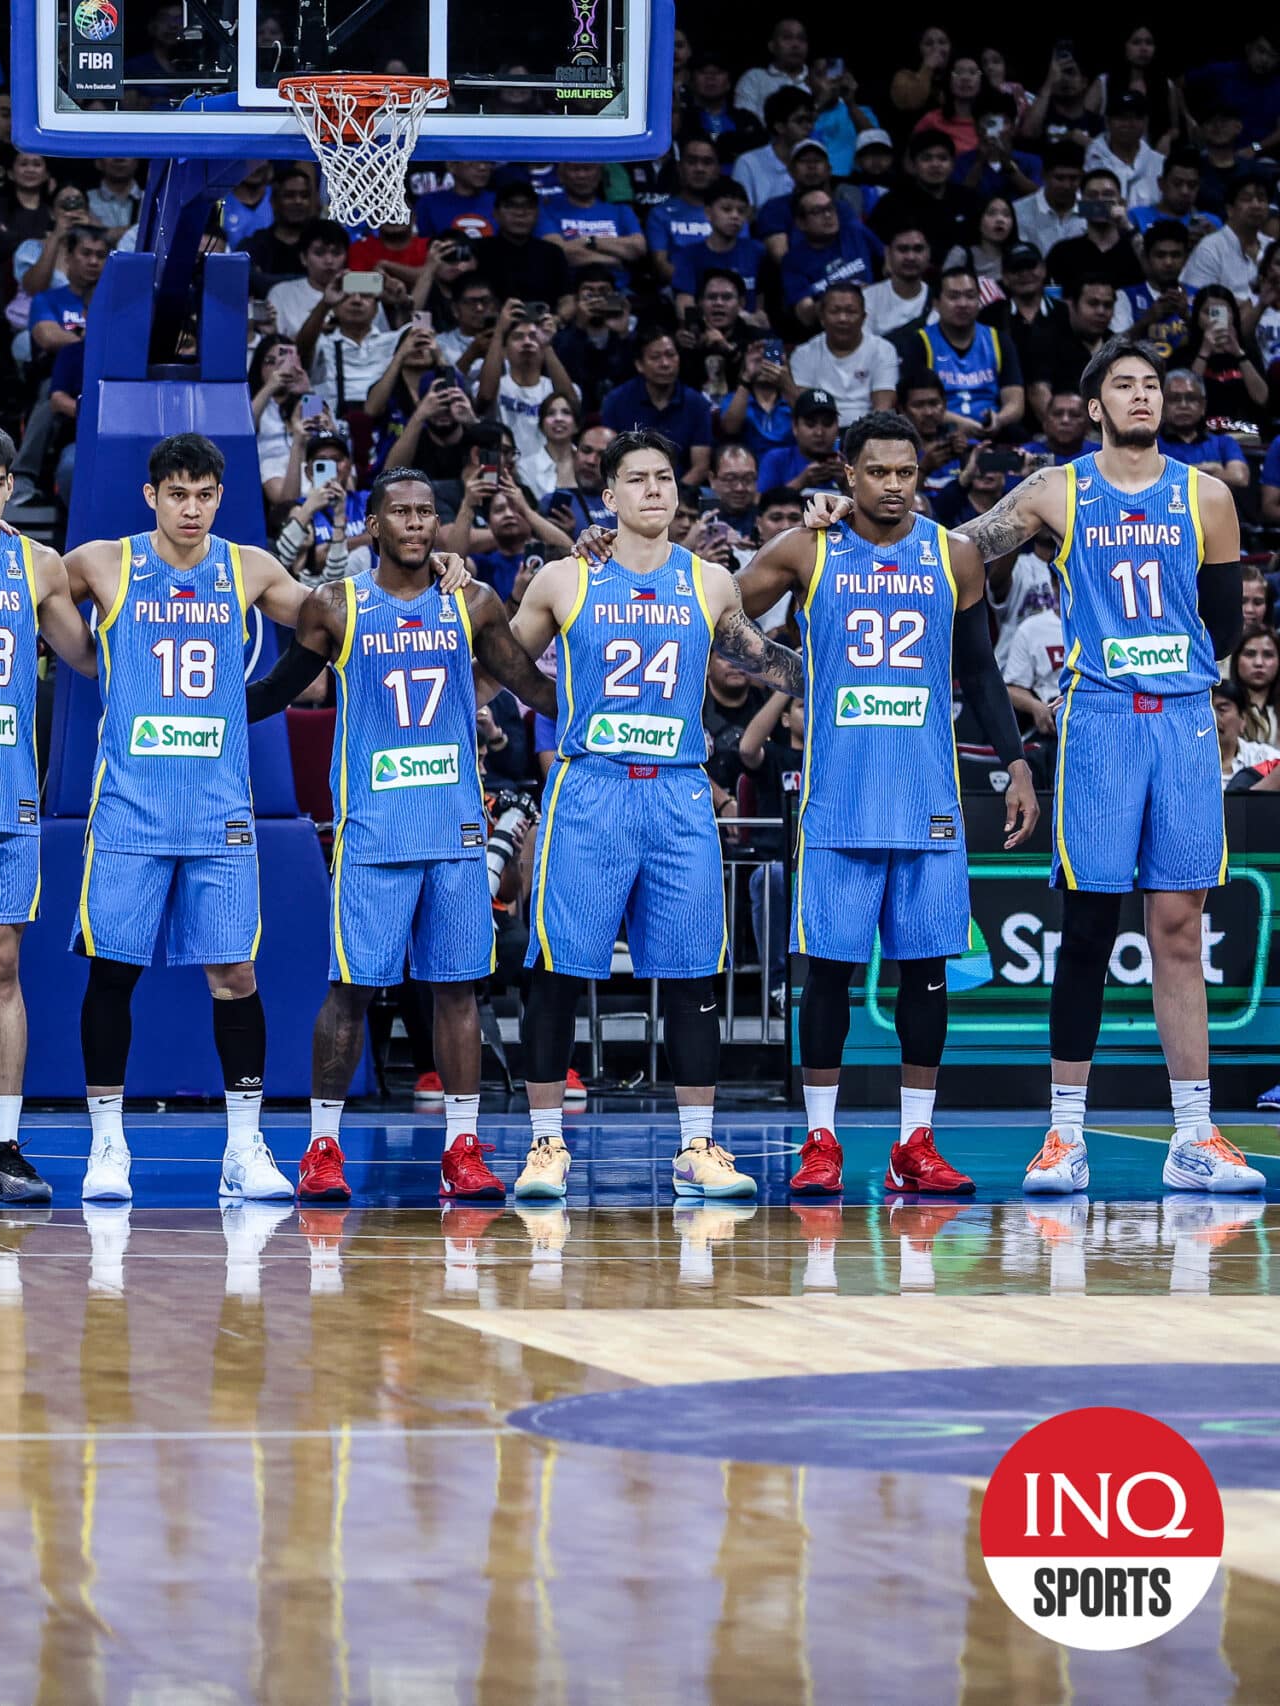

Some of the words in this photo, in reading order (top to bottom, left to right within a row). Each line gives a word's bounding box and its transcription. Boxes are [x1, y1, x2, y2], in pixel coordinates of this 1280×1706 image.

[78, 52, 113, 70] FIBA
[556, 88, 614, 99] QUALIFIERS
[1087, 525, 1180, 547] PILIPINAS
[837, 574, 933, 594] PILIPINAS
[1110, 561, 1162, 619] 11
[136, 601, 229, 623] PILIPINAS
[595, 604, 690, 625] PILIPINAS
[363, 630, 457, 655] PILIPINAS
[847, 609, 925, 668] 32
[1127, 643, 1184, 666] Smart
[152, 639, 215, 698] 18
[604, 639, 679, 699] 24
[383, 667, 446, 727] 17
[864, 695, 921, 716] Smart
[162, 725, 218, 747] Smart
[618, 722, 675, 747] Smart
[400, 754, 455, 776] Smart
[1000, 912, 1225, 985] Sat
